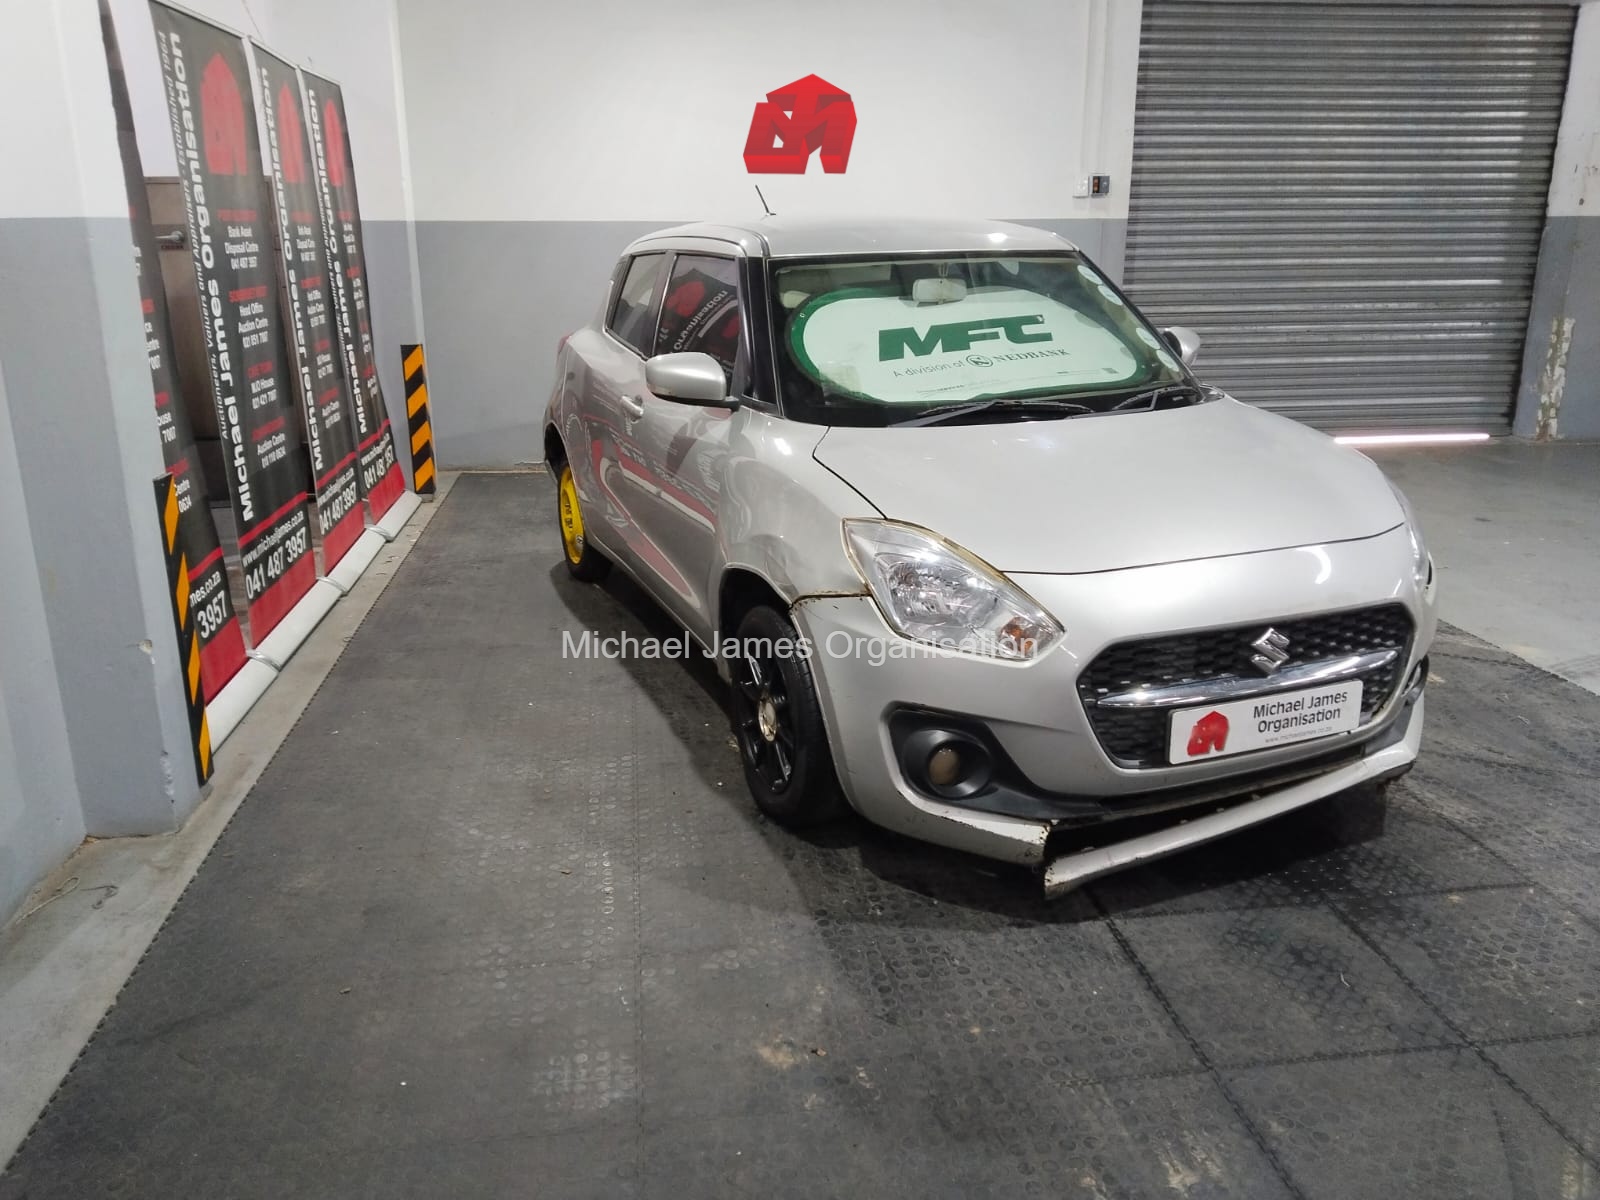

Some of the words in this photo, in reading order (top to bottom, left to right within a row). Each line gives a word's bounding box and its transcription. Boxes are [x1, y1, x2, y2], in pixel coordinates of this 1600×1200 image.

[165, 75, 185, 166] Established
[169, 32, 215, 269] Organisation
[262, 67, 293, 260] Organisation
[308, 89, 338, 254] Organisation
[182, 179, 200, 258] Appraisers
[194, 262, 204, 281] and
[334, 261, 352, 338] James
[198, 286, 214, 348] Valuers
[207, 279, 233, 388] James
[288, 269, 307, 359] James
[879, 314, 1053, 362] MFC
[346, 343, 367, 434] Michael
[894, 369, 903, 378] A
[905, 362, 951, 377] division
[953, 359, 966, 368] of
[993, 348, 1071, 363] NEDBANK
[301, 366, 323, 470] Michael
[223, 396, 254, 522] Michael
[332, 495, 344, 521] 487
[189, 571, 221, 608] mes.co.za
[246, 563, 266, 599] 041
[268, 546, 284, 579] 487
[285, 526, 306, 563] 3957
[197, 590, 227, 638] 3957
[1253, 697, 1305, 719] Michael
[1307, 692, 1348, 709] James
[1258, 708, 1341, 733] Organisation
